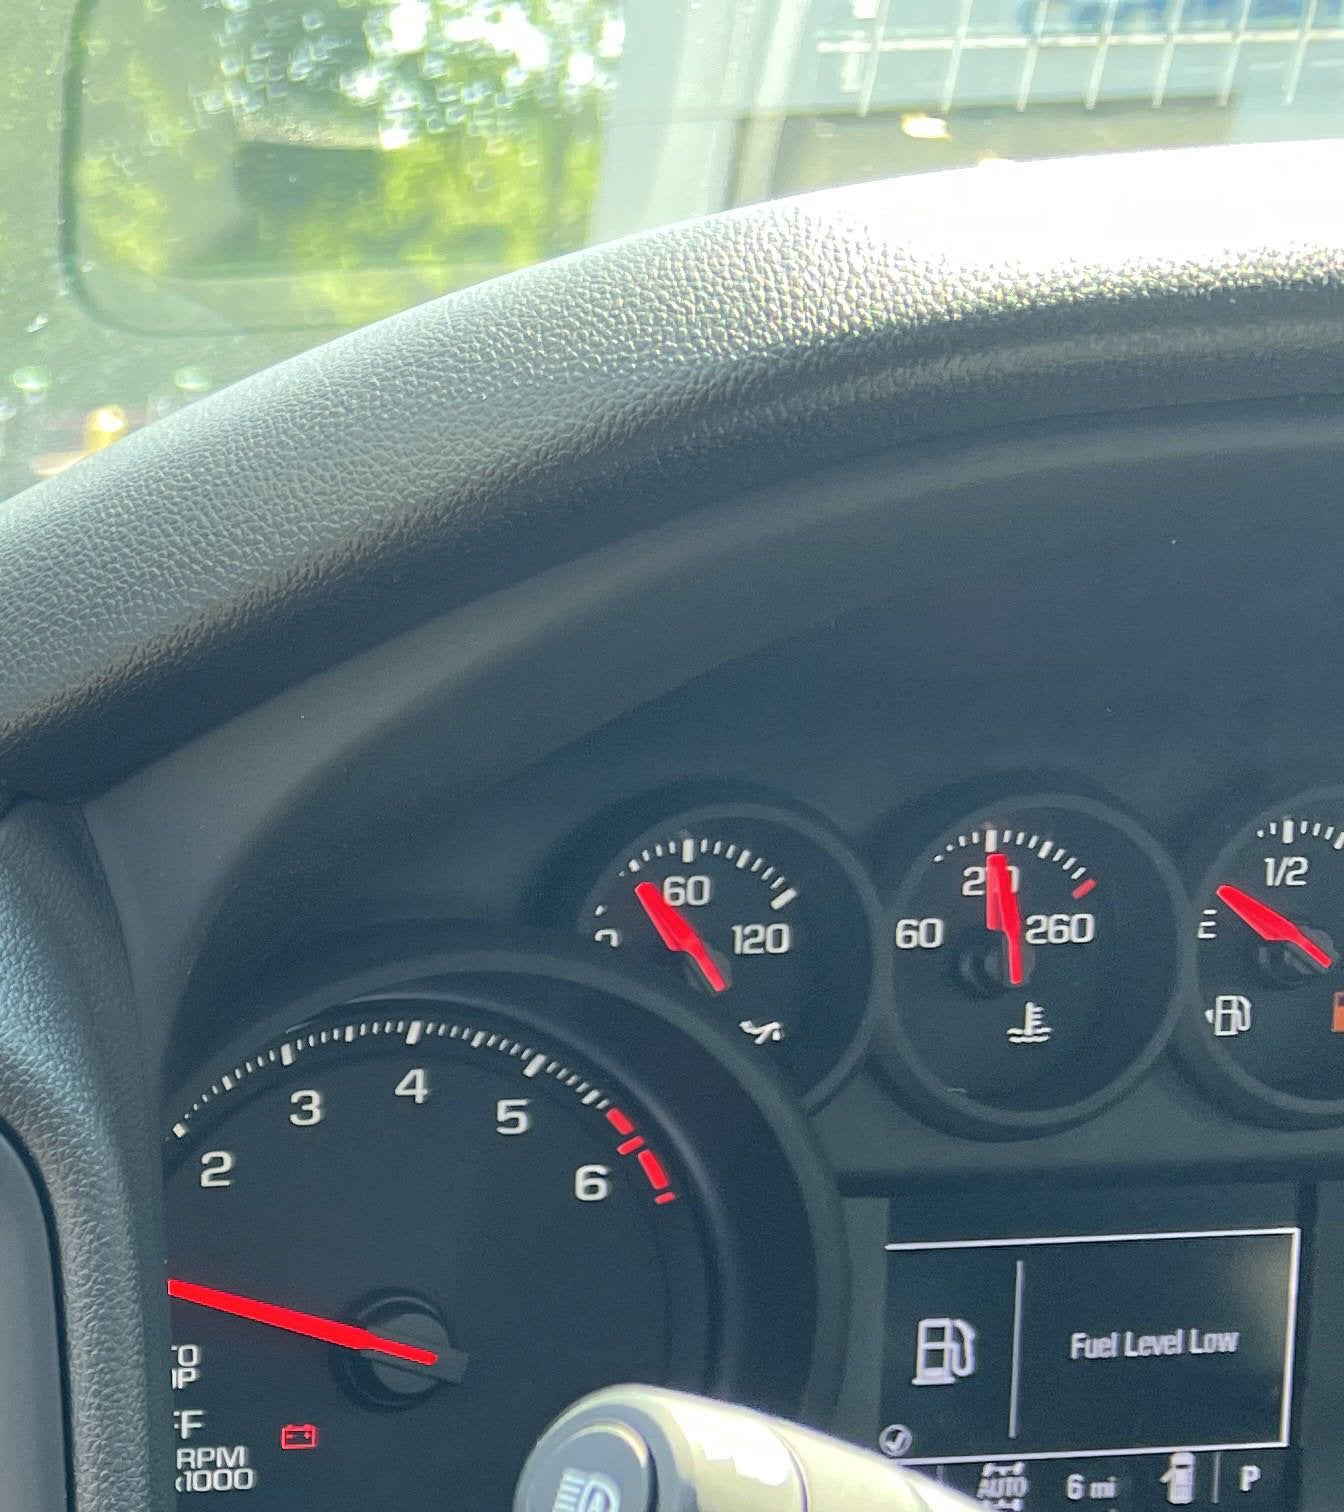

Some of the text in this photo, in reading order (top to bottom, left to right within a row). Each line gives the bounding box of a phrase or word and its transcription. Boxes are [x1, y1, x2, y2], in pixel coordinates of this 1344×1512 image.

[1264, 856, 1309, 887] 1/2
[663, 874, 712, 907] 60
[730, 922, 792, 956] 120
[895, 917, 945, 950] 60
[1024, 913, 1096, 945] 260
[394, 1068, 430, 1104] 4
[289, 1089, 323, 1126] 3
[496, 1098, 531, 1136] 5
[200, 1150, 234, 1188] 2
[575, 1164, 611, 1202] 6
[1070, 1327, 1240, 1360] Fuel Level Low
[176, 1445, 247, 1470] RPM
[977, 1475, 1029, 1500] AUTO
[1066, 1473, 1119, 1500] 6 mi
[1238, 1465, 1262, 1492] P
